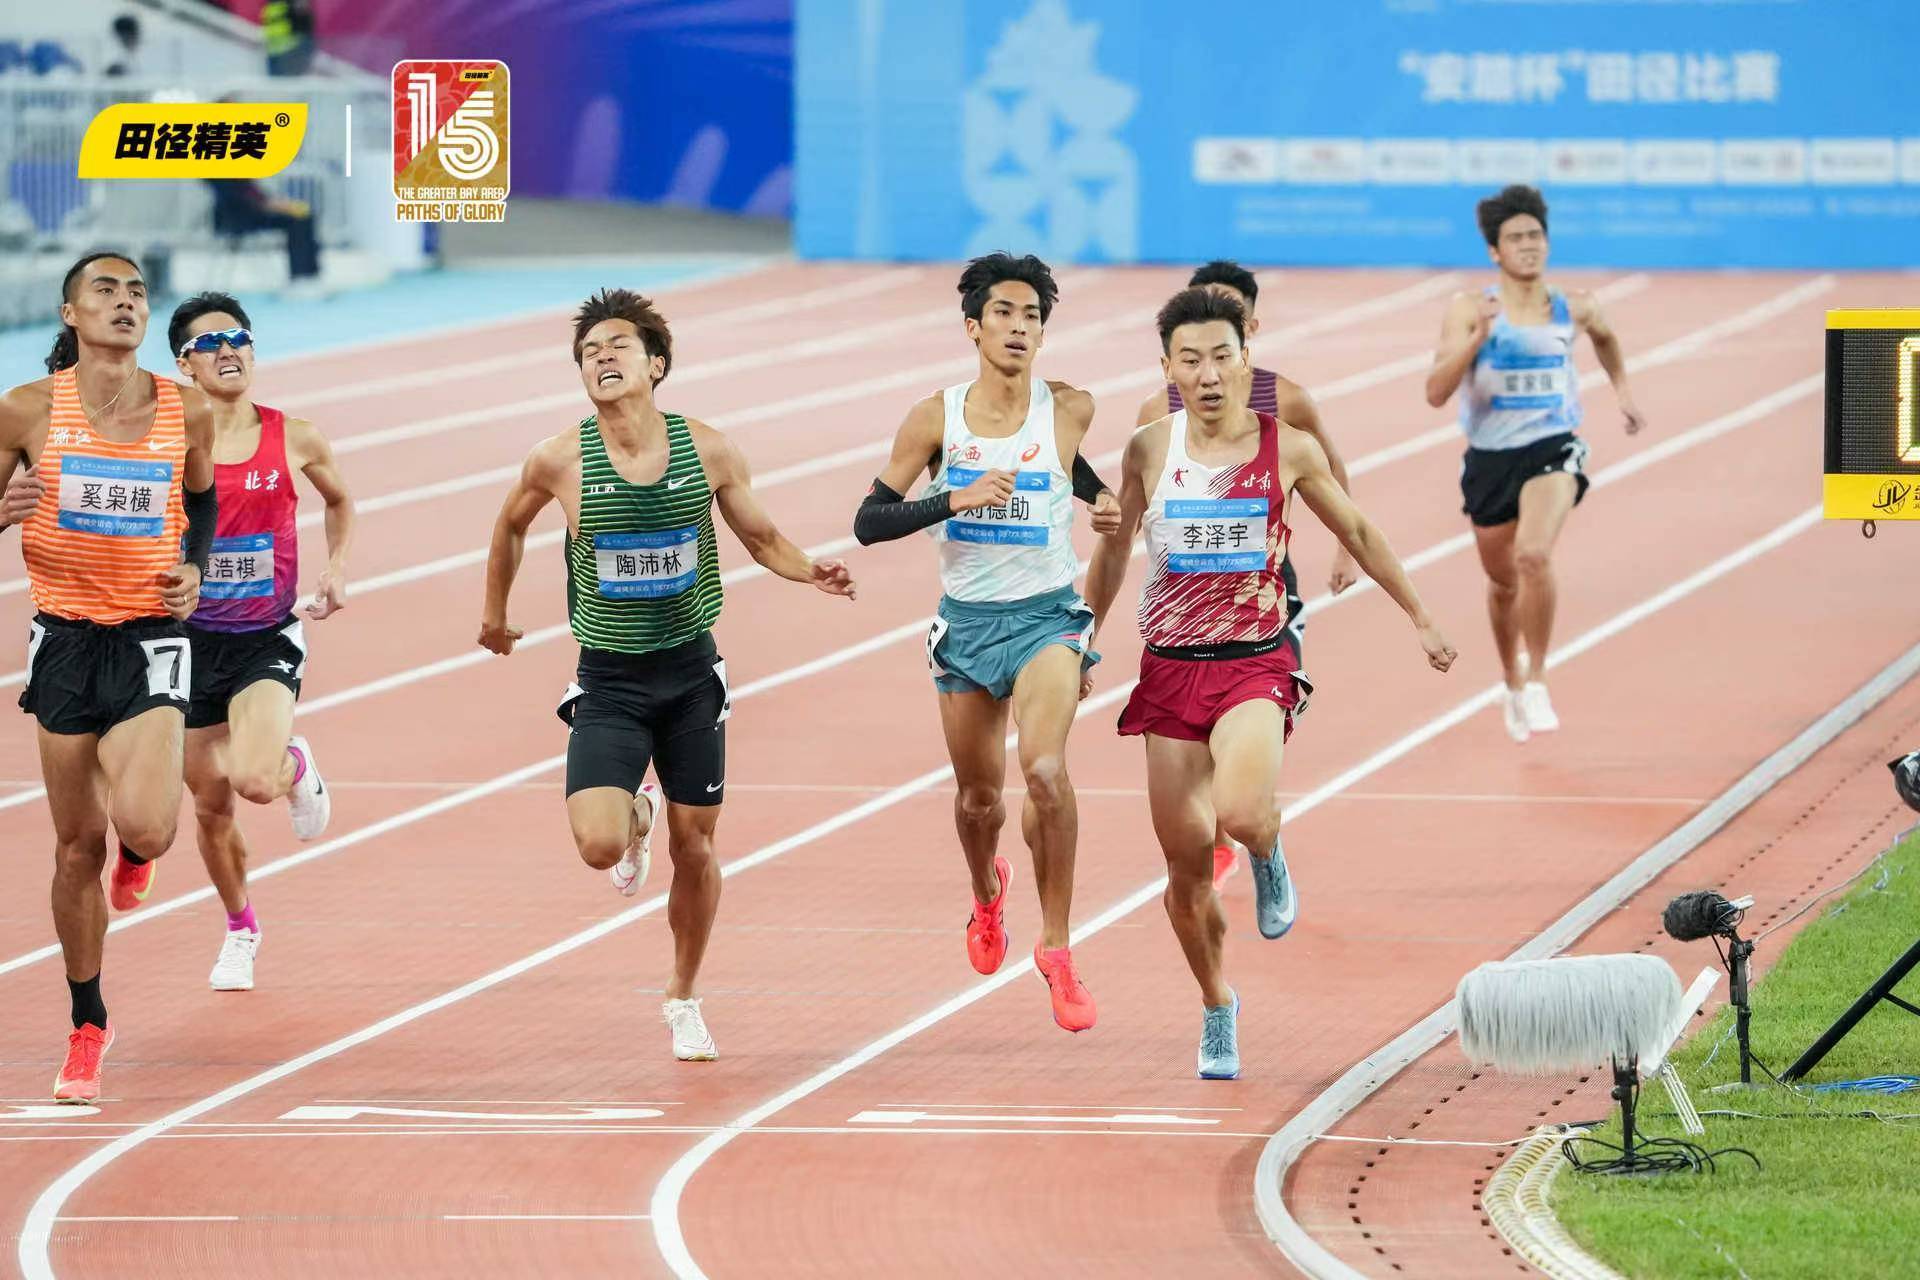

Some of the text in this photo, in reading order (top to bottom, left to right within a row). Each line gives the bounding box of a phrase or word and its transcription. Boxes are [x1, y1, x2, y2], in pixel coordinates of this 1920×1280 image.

[245, 470, 280, 491] 北京
[1241, 470, 1271, 498] 甘肃
[80, 483, 152, 513] 奚枭横
[1183, 522, 1249, 549] 李泽宇
[616, 550, 682, 577] 陶沛林
[153, 645, 185, 690] 7
